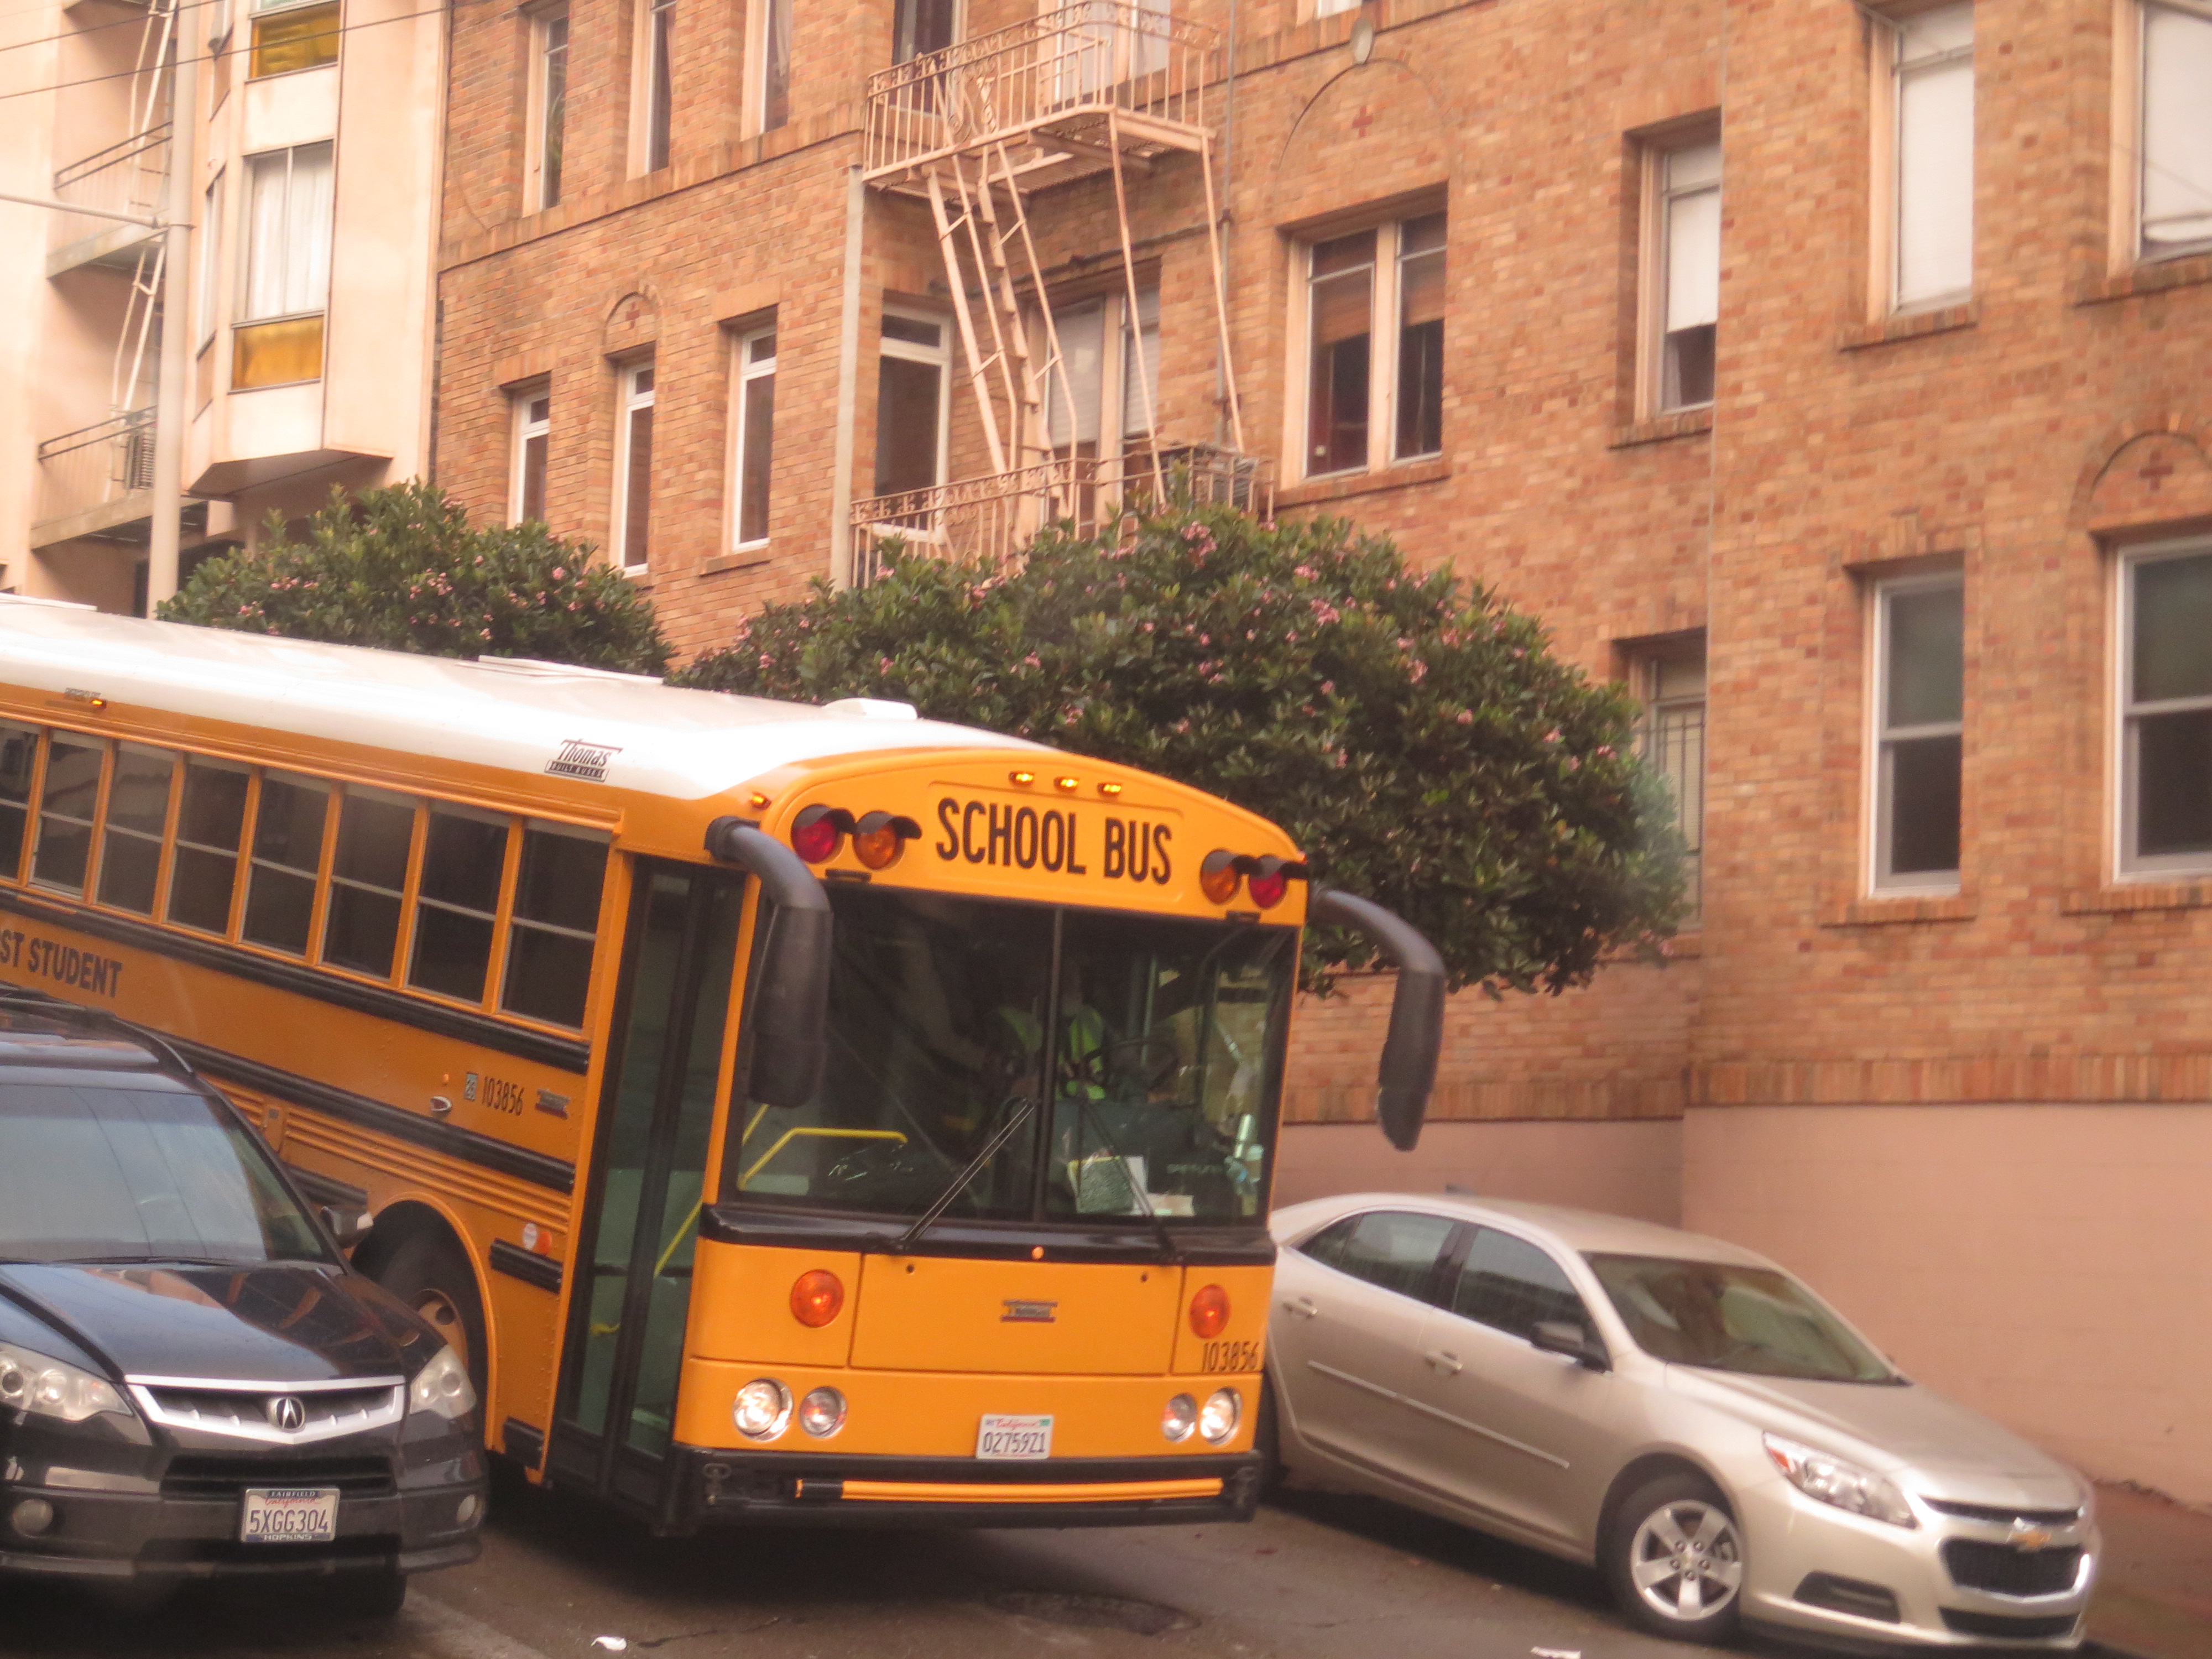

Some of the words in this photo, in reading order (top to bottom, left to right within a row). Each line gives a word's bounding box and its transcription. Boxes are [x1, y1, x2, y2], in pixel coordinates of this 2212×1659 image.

[557, 738, 624, 767] Thomas
[551, 762, 574, 773] BUILT
[575, 765, 602, 778] BUSES
[935, 797, 1086, 875] SCHOOL
[1103, 817, 1172, 885] BUS
[28, 937, 123, 998] STUDENT
[482, 1076, 525, 1117] 103856
[1202, 1341, 1260, 1373] 103856
[249, 1509, 328, 1533] 5XGG304
